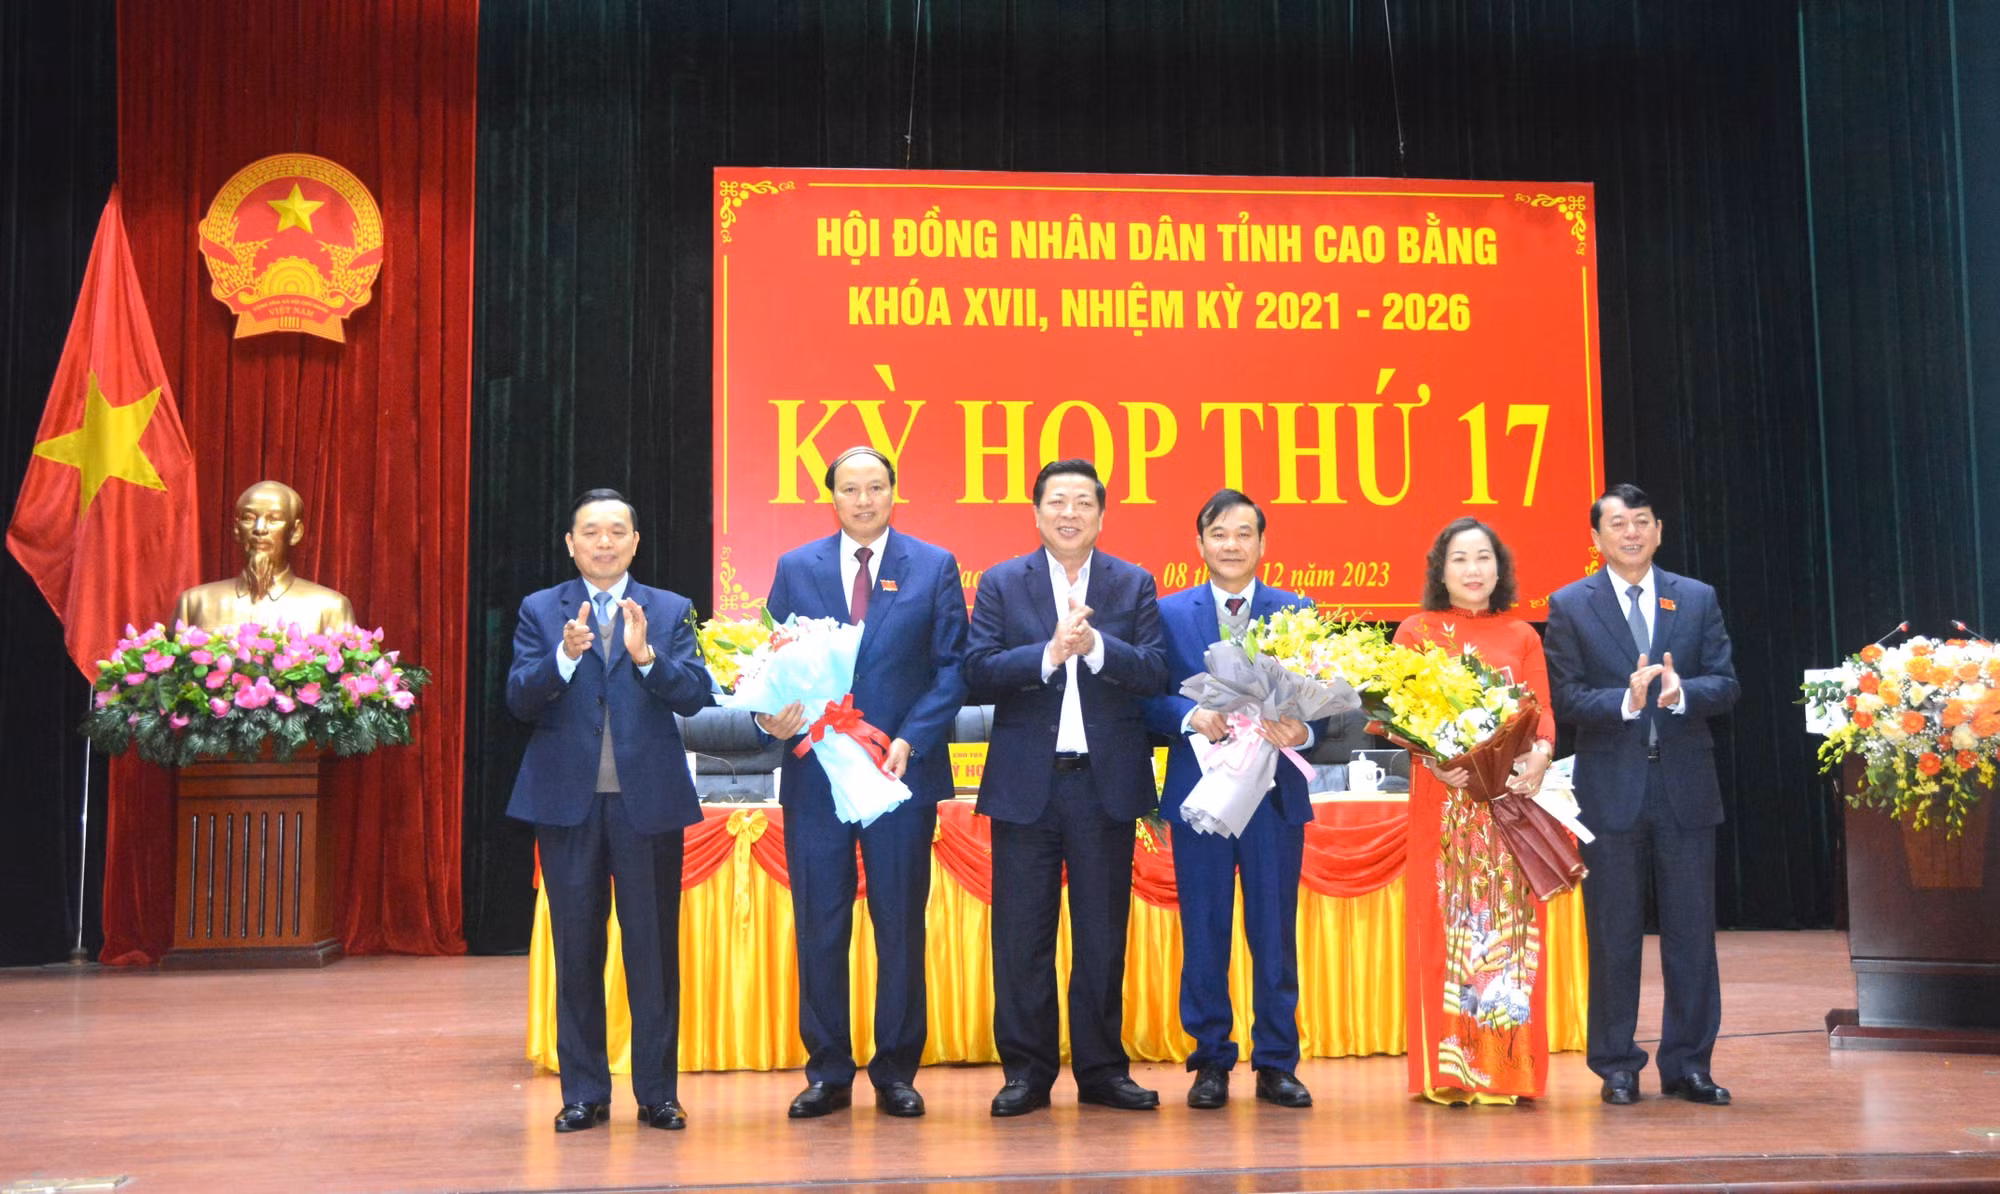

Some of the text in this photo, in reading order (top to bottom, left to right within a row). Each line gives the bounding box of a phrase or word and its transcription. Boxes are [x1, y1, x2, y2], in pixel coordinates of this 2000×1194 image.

[817, 206, 1497, 265] HỘI ĐỒNG NHÂN DÂN TỈNH CAO BẰNG
[849, 278, 1471, 336] KHÓA XVII, NHIỆM KỲ 2021 - 2026
[768, 364, 927, 504] KỲ
[1201, 368, 1431, 506] THỨ
[1458, 402, 1550, 507] 17
[1164, 563, 1188, 588] 08
[1262, 562, 1284, 587] 12
[1290, 564, 1335, 588] năm
[1341, 562, 1391, 587] 2023
